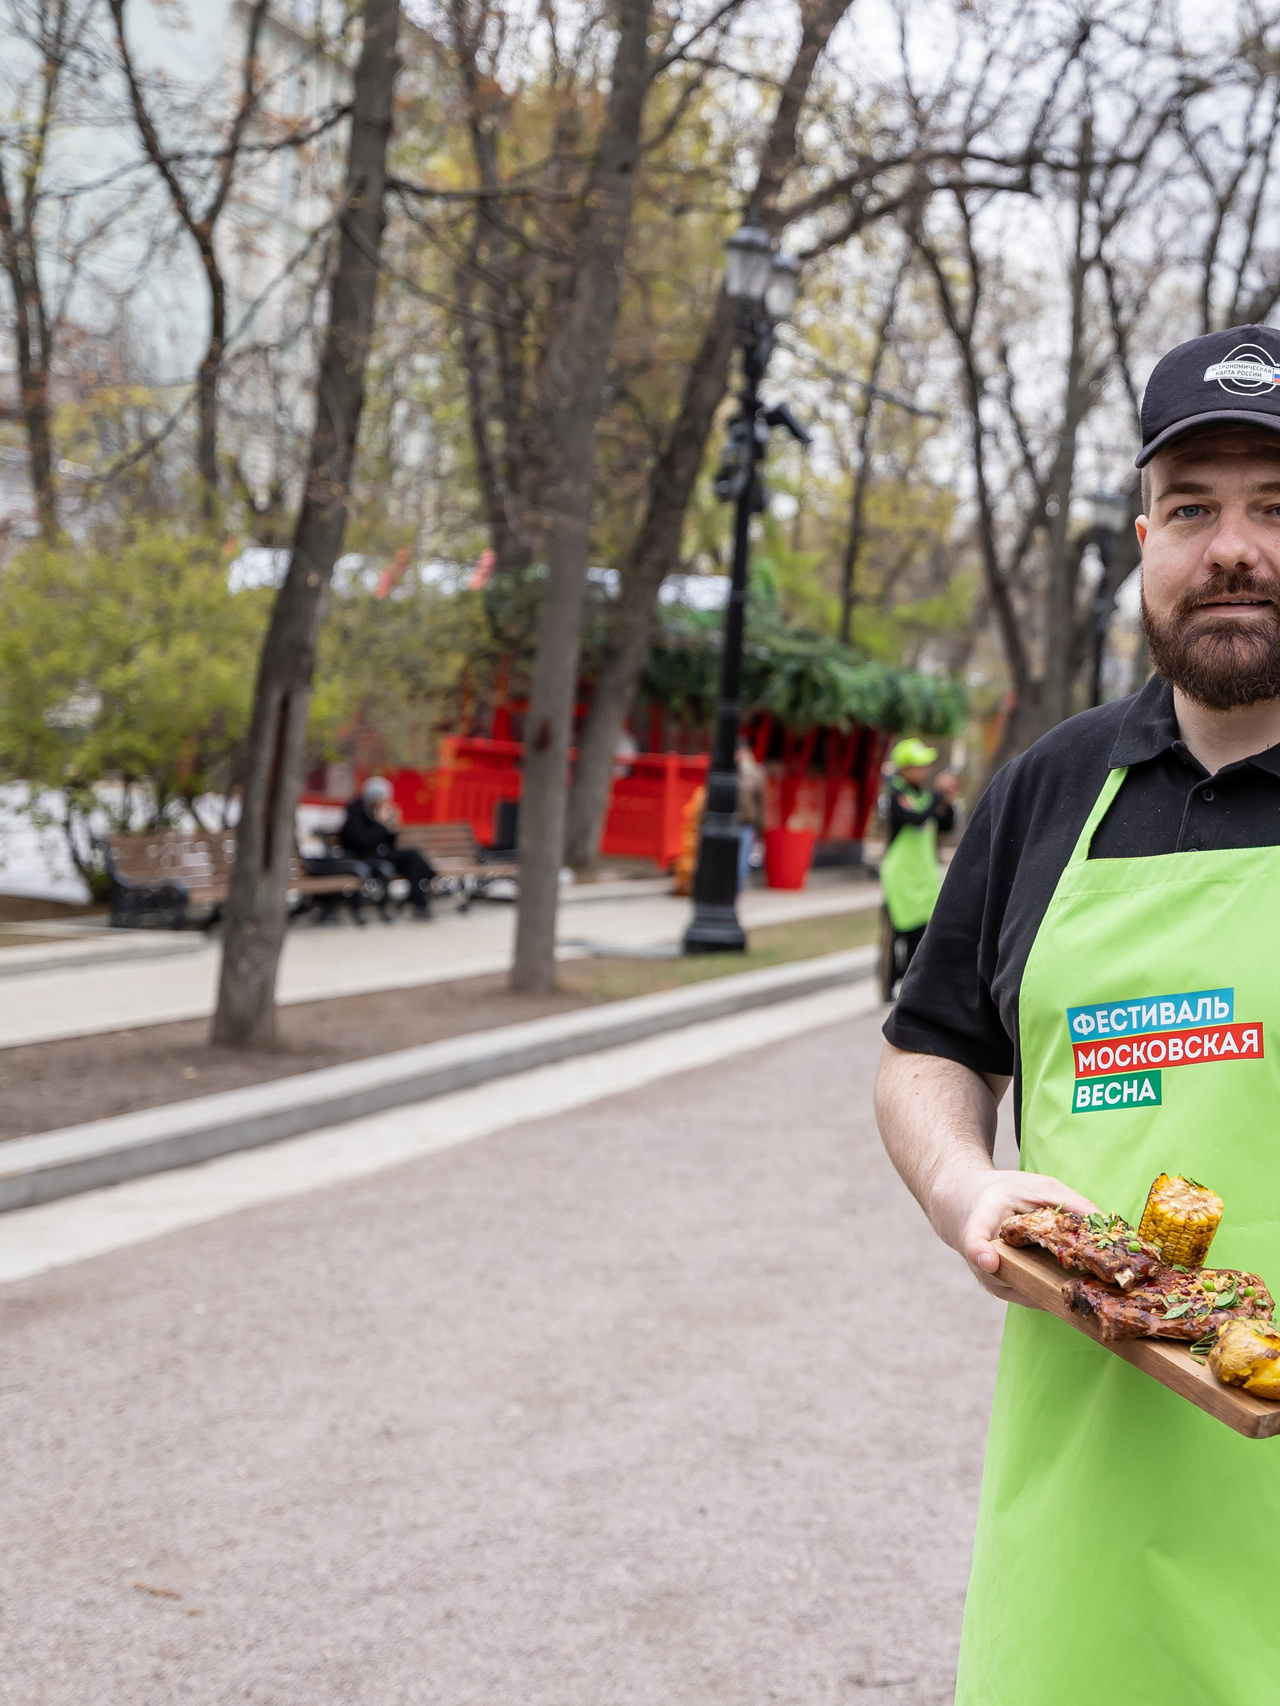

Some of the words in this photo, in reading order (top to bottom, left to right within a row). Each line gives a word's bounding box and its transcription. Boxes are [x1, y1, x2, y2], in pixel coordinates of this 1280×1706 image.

[1236, 370, 1262, 378] РОССИИ
[1073, 996, 1230, 1035] ФЕСТИВАЛЬ
[1077, 1029, 1259, 1072] МОСКОВСКАЯ
[1075, 1078, 1156, 1108] ВЕСНА
